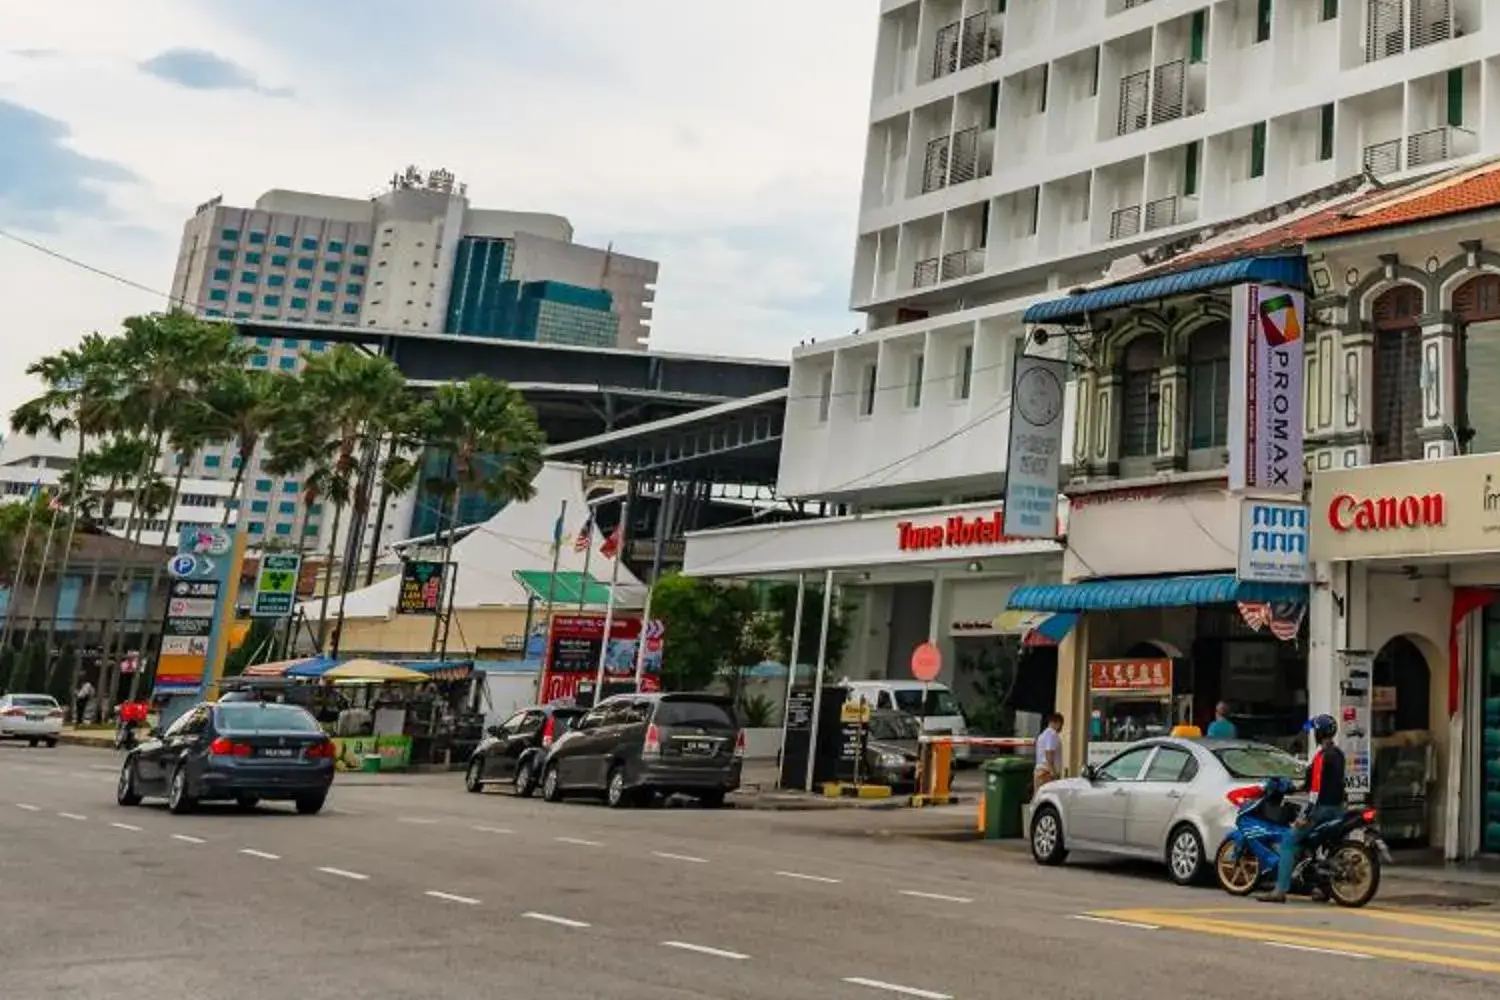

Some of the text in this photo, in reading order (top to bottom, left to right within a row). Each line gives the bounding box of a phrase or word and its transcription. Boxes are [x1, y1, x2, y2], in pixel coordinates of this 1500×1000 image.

[1274, 350, 1289, 486] PROMAX
[897, 511, 1028, 550] Tune Hotel
[1328, 491, 1446, 533] Canon
